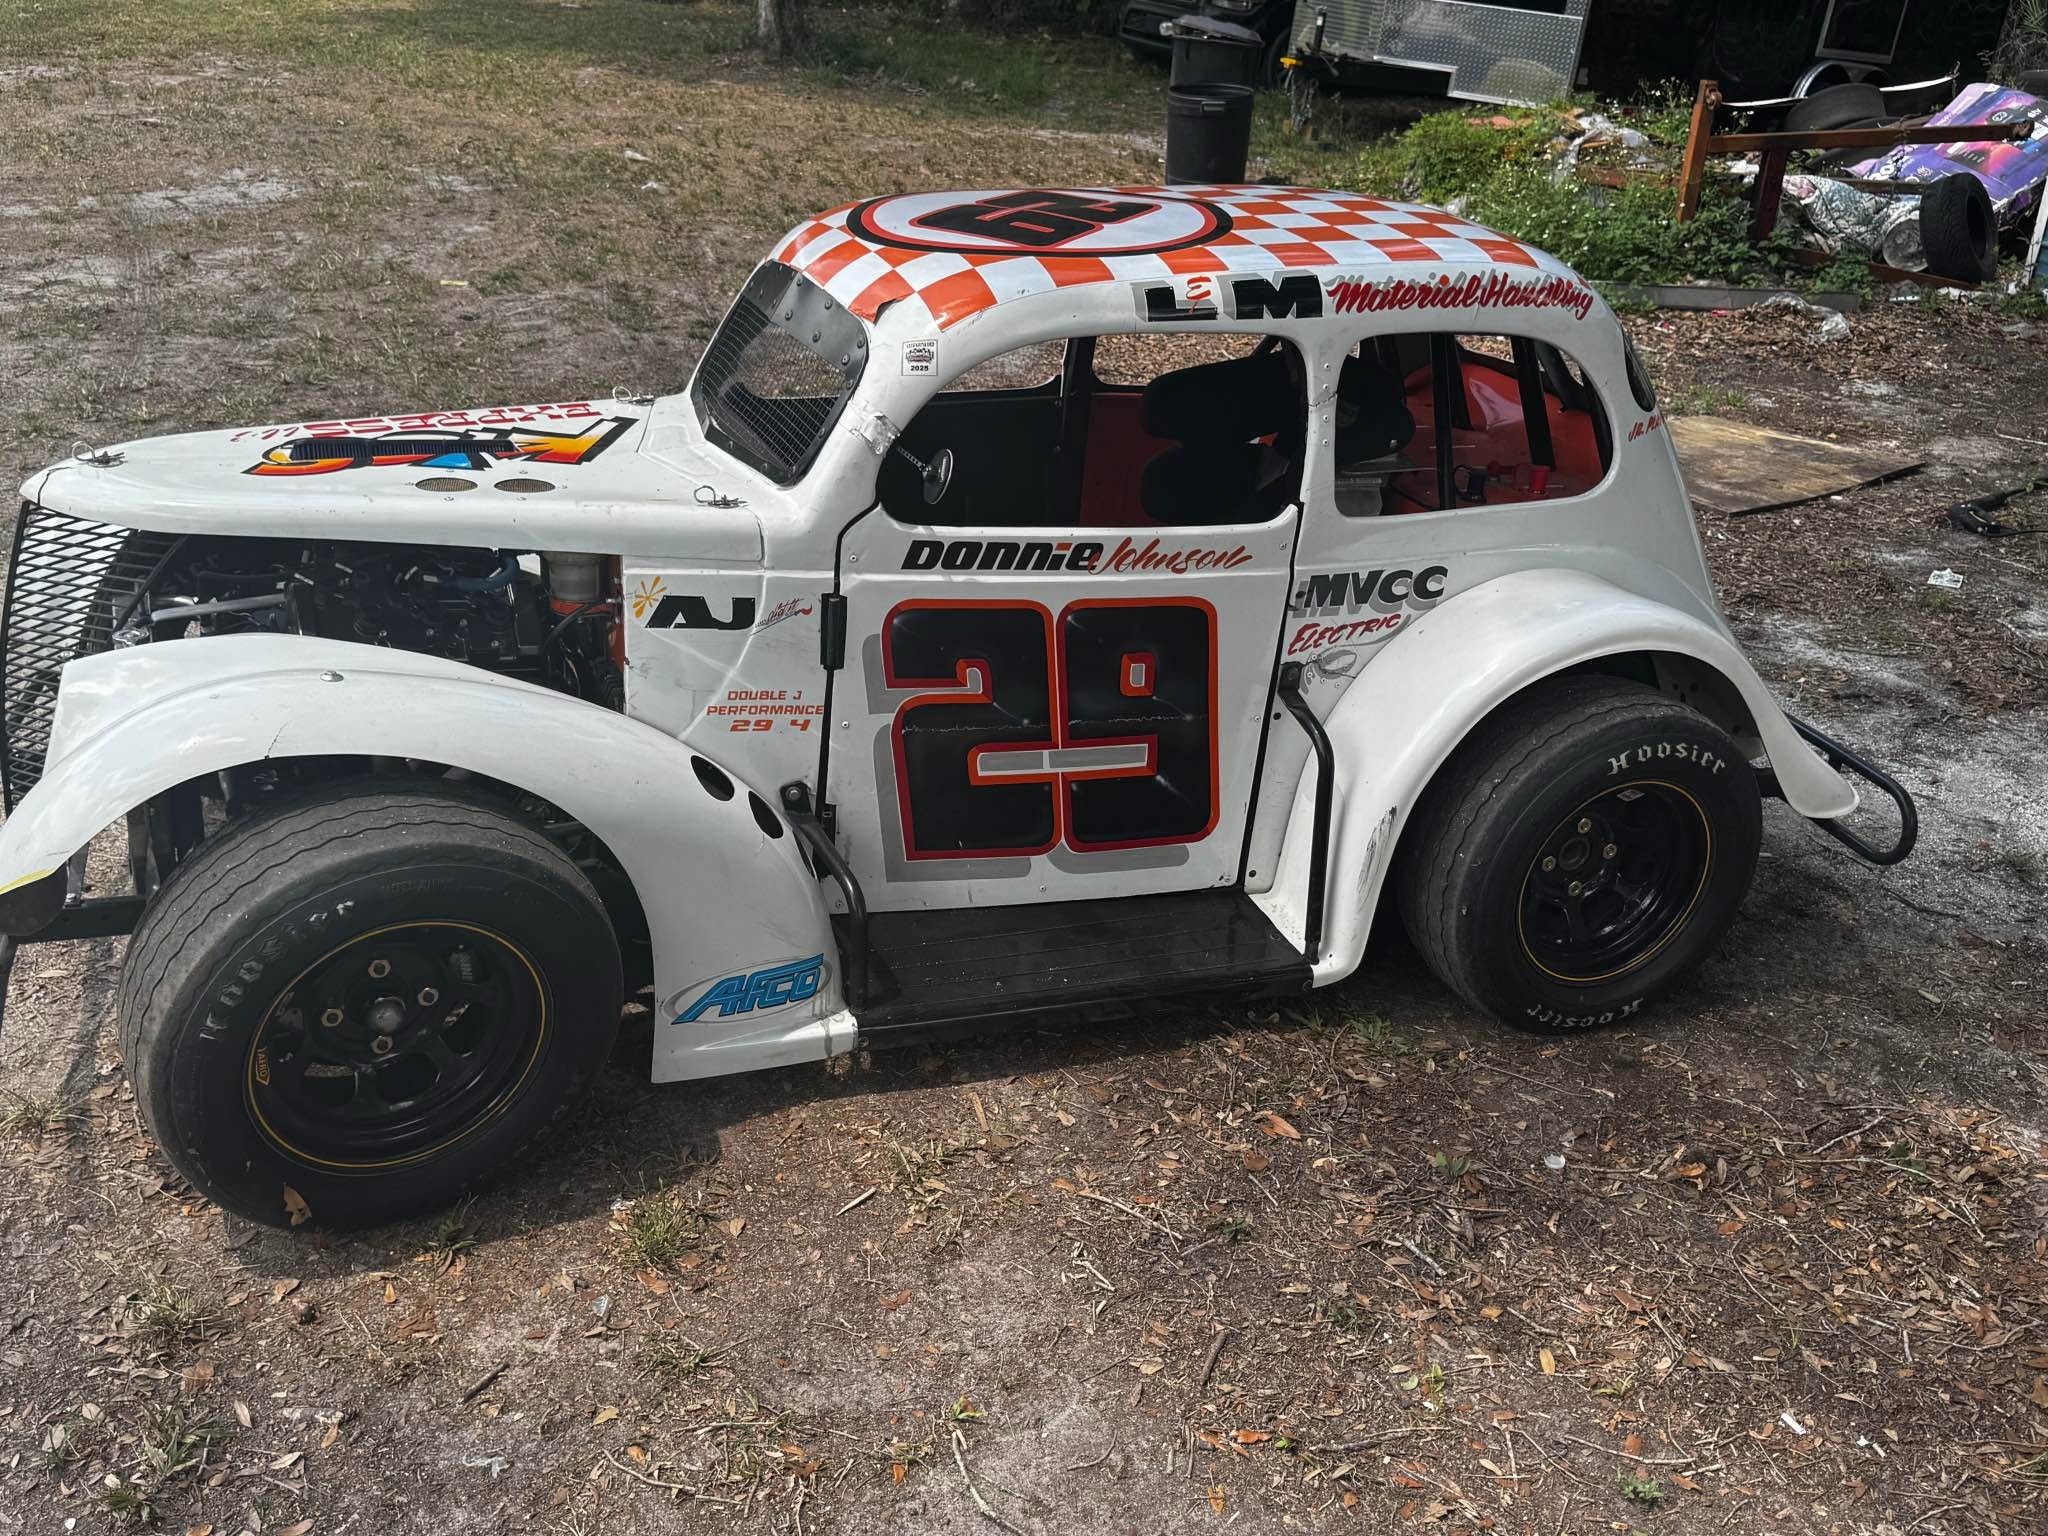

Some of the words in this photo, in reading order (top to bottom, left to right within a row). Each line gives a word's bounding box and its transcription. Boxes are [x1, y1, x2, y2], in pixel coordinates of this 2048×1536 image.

[1327, 274, 1482, 315] Material
[1479, 271, 1594, 321] Handling
[302, 402, 602, 438] EXPRESS
[1087, 536, 1253, 576] Johnson
[1300, 565, 1449, 612] MVCC
[706, 704, 824, 716] PERFORMANCE
[727, 690, 788, 701] DOUBLE
[792, 690, 802, 701] J
[729, 719, 774, 732] 29
[790, 718, 812, 732] 4
[880, 595, 1218, 863] 29
[1606, 741, 1727, 777] Hoosier
[670, 952, 825, 1026] AFCO
[1526, 997, 1645, 1029] Hoosier
